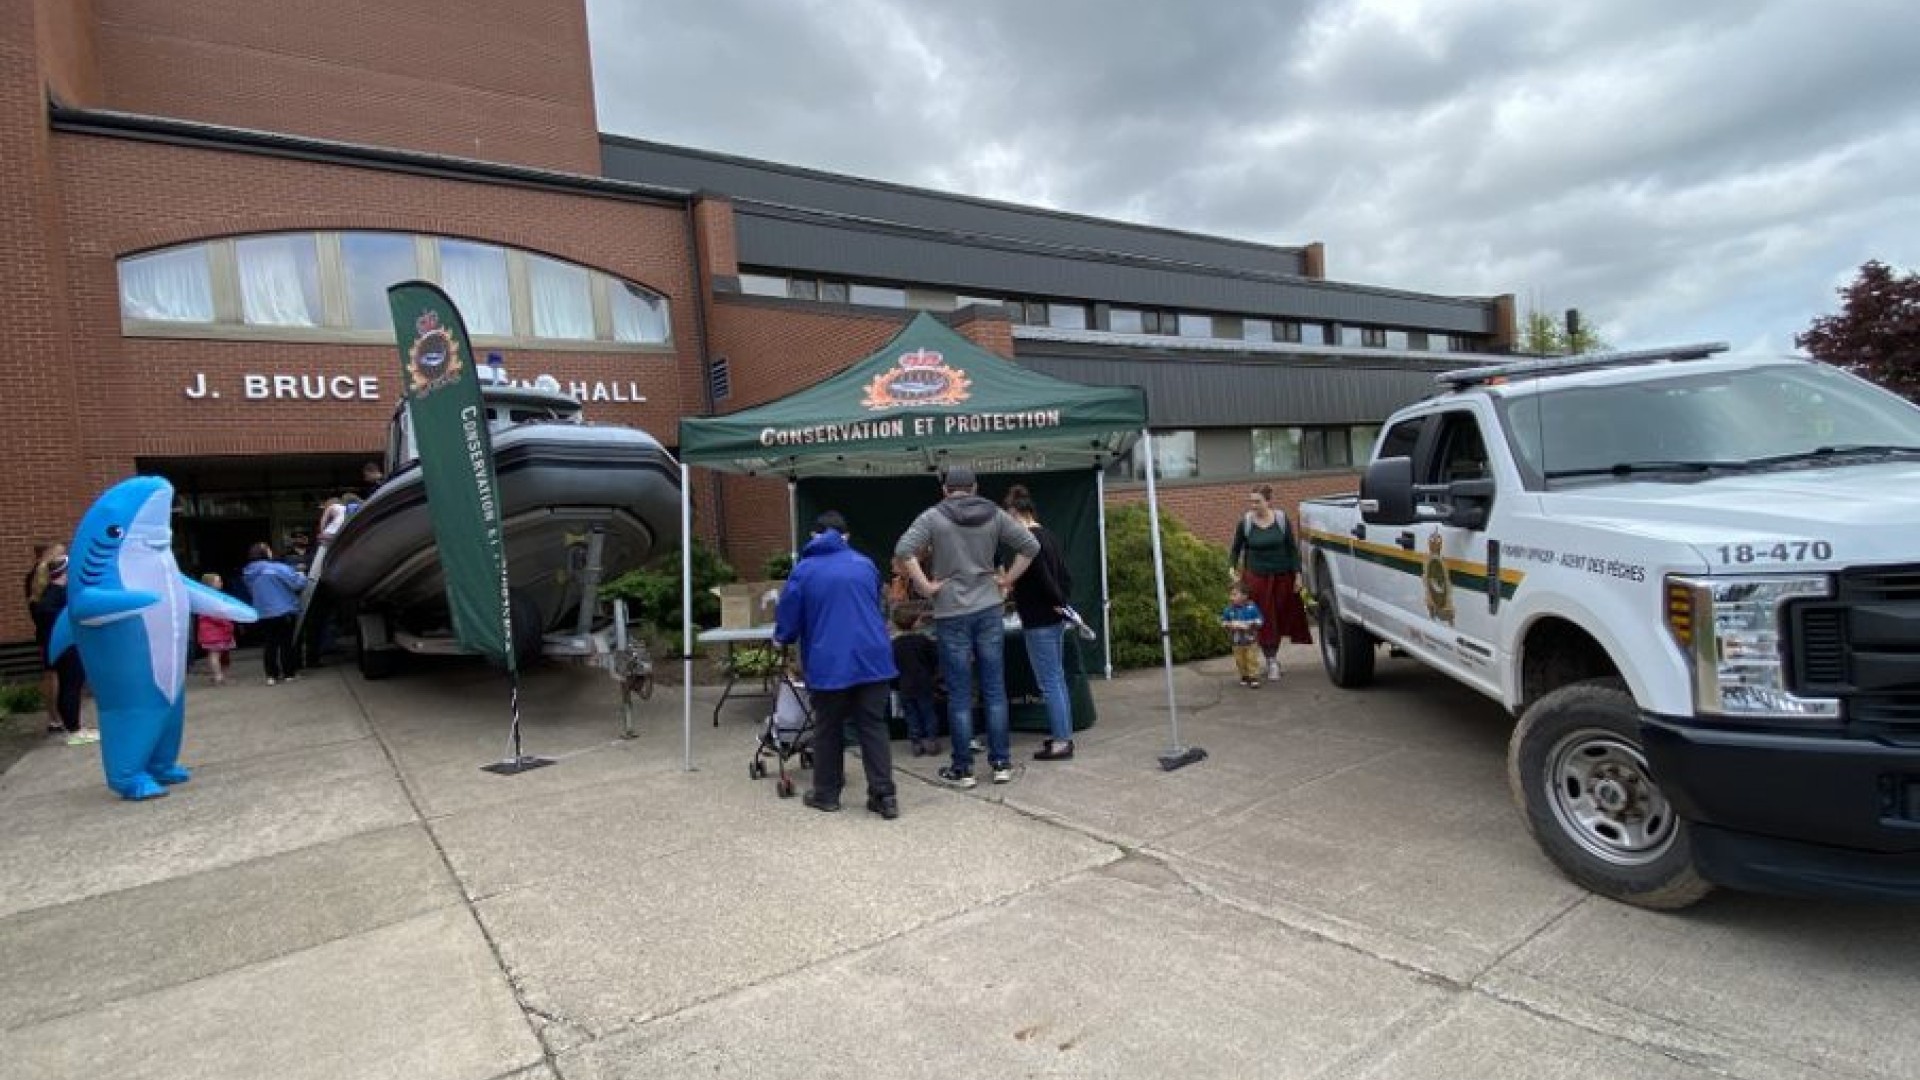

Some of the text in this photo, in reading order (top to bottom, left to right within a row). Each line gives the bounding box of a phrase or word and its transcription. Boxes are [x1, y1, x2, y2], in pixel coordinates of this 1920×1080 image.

[186, 373, 220, 399] J.
[244, 375, 380, 399] BRUCE
[568, 380, 647, 403] HALL
[760, 410, 1061, 447] CONSERVATION ET PROTECTION
[461, 405, 494, 522] CONSERVATION
[1587, 556, 1606, 575] DES
[1716, 541, 1832, 564] 18-470
